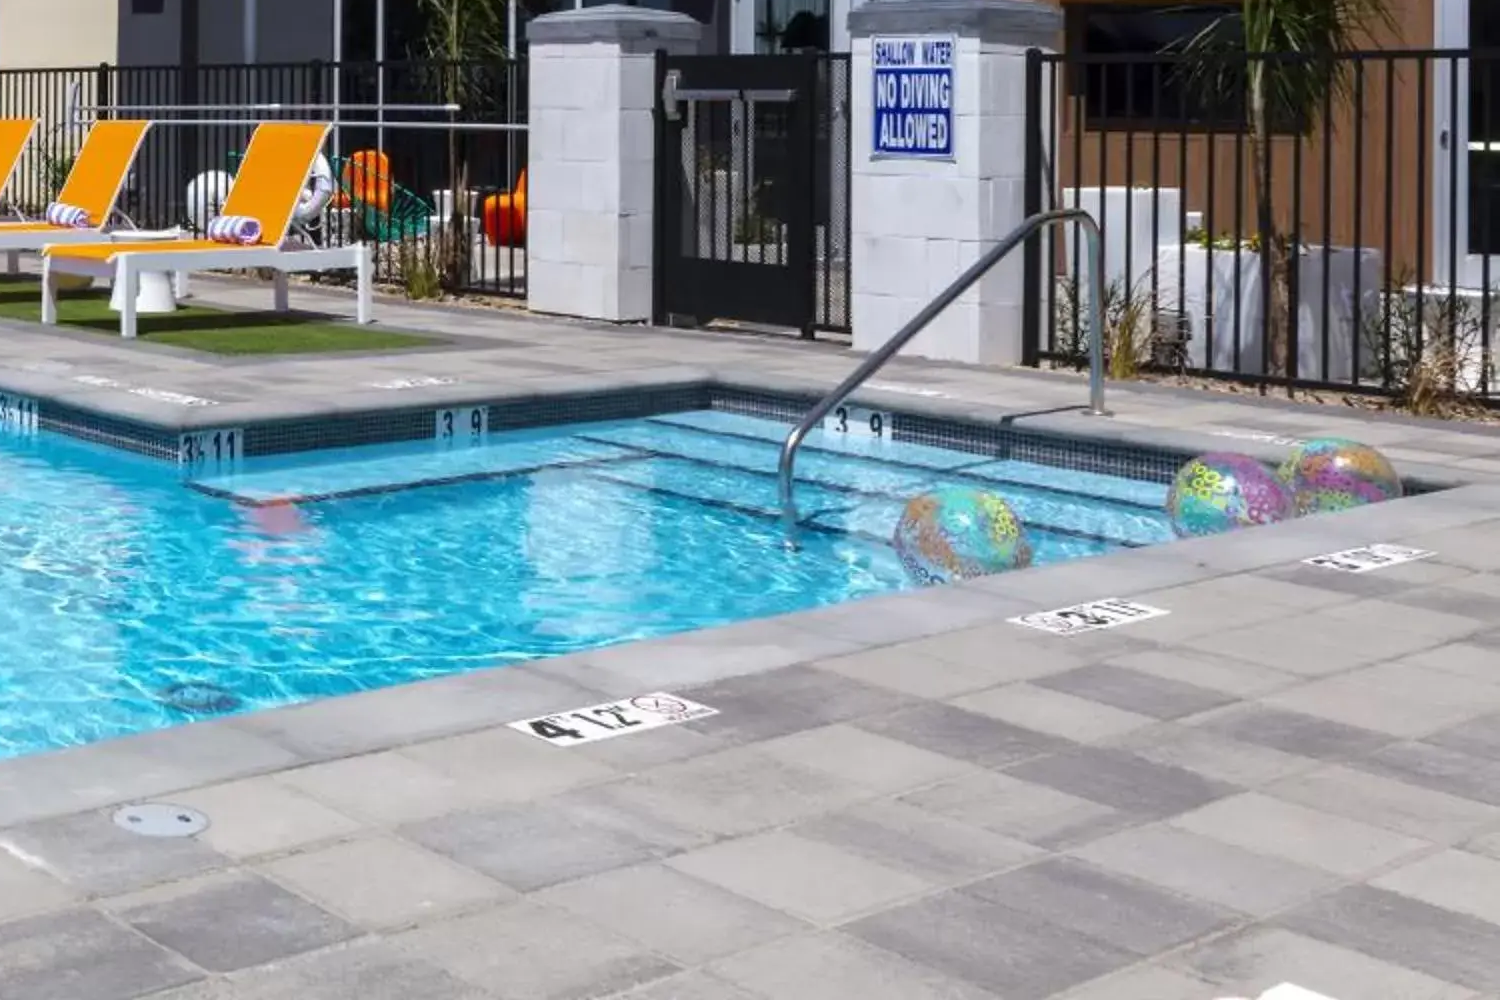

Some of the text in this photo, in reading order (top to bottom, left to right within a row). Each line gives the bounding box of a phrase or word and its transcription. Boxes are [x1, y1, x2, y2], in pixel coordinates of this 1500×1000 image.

[875, 41, 951, 65] SHALLOW WATER
[877, 73, 950, 109] NO DIVING
[879, 113, 948, 149] ALLOWED
